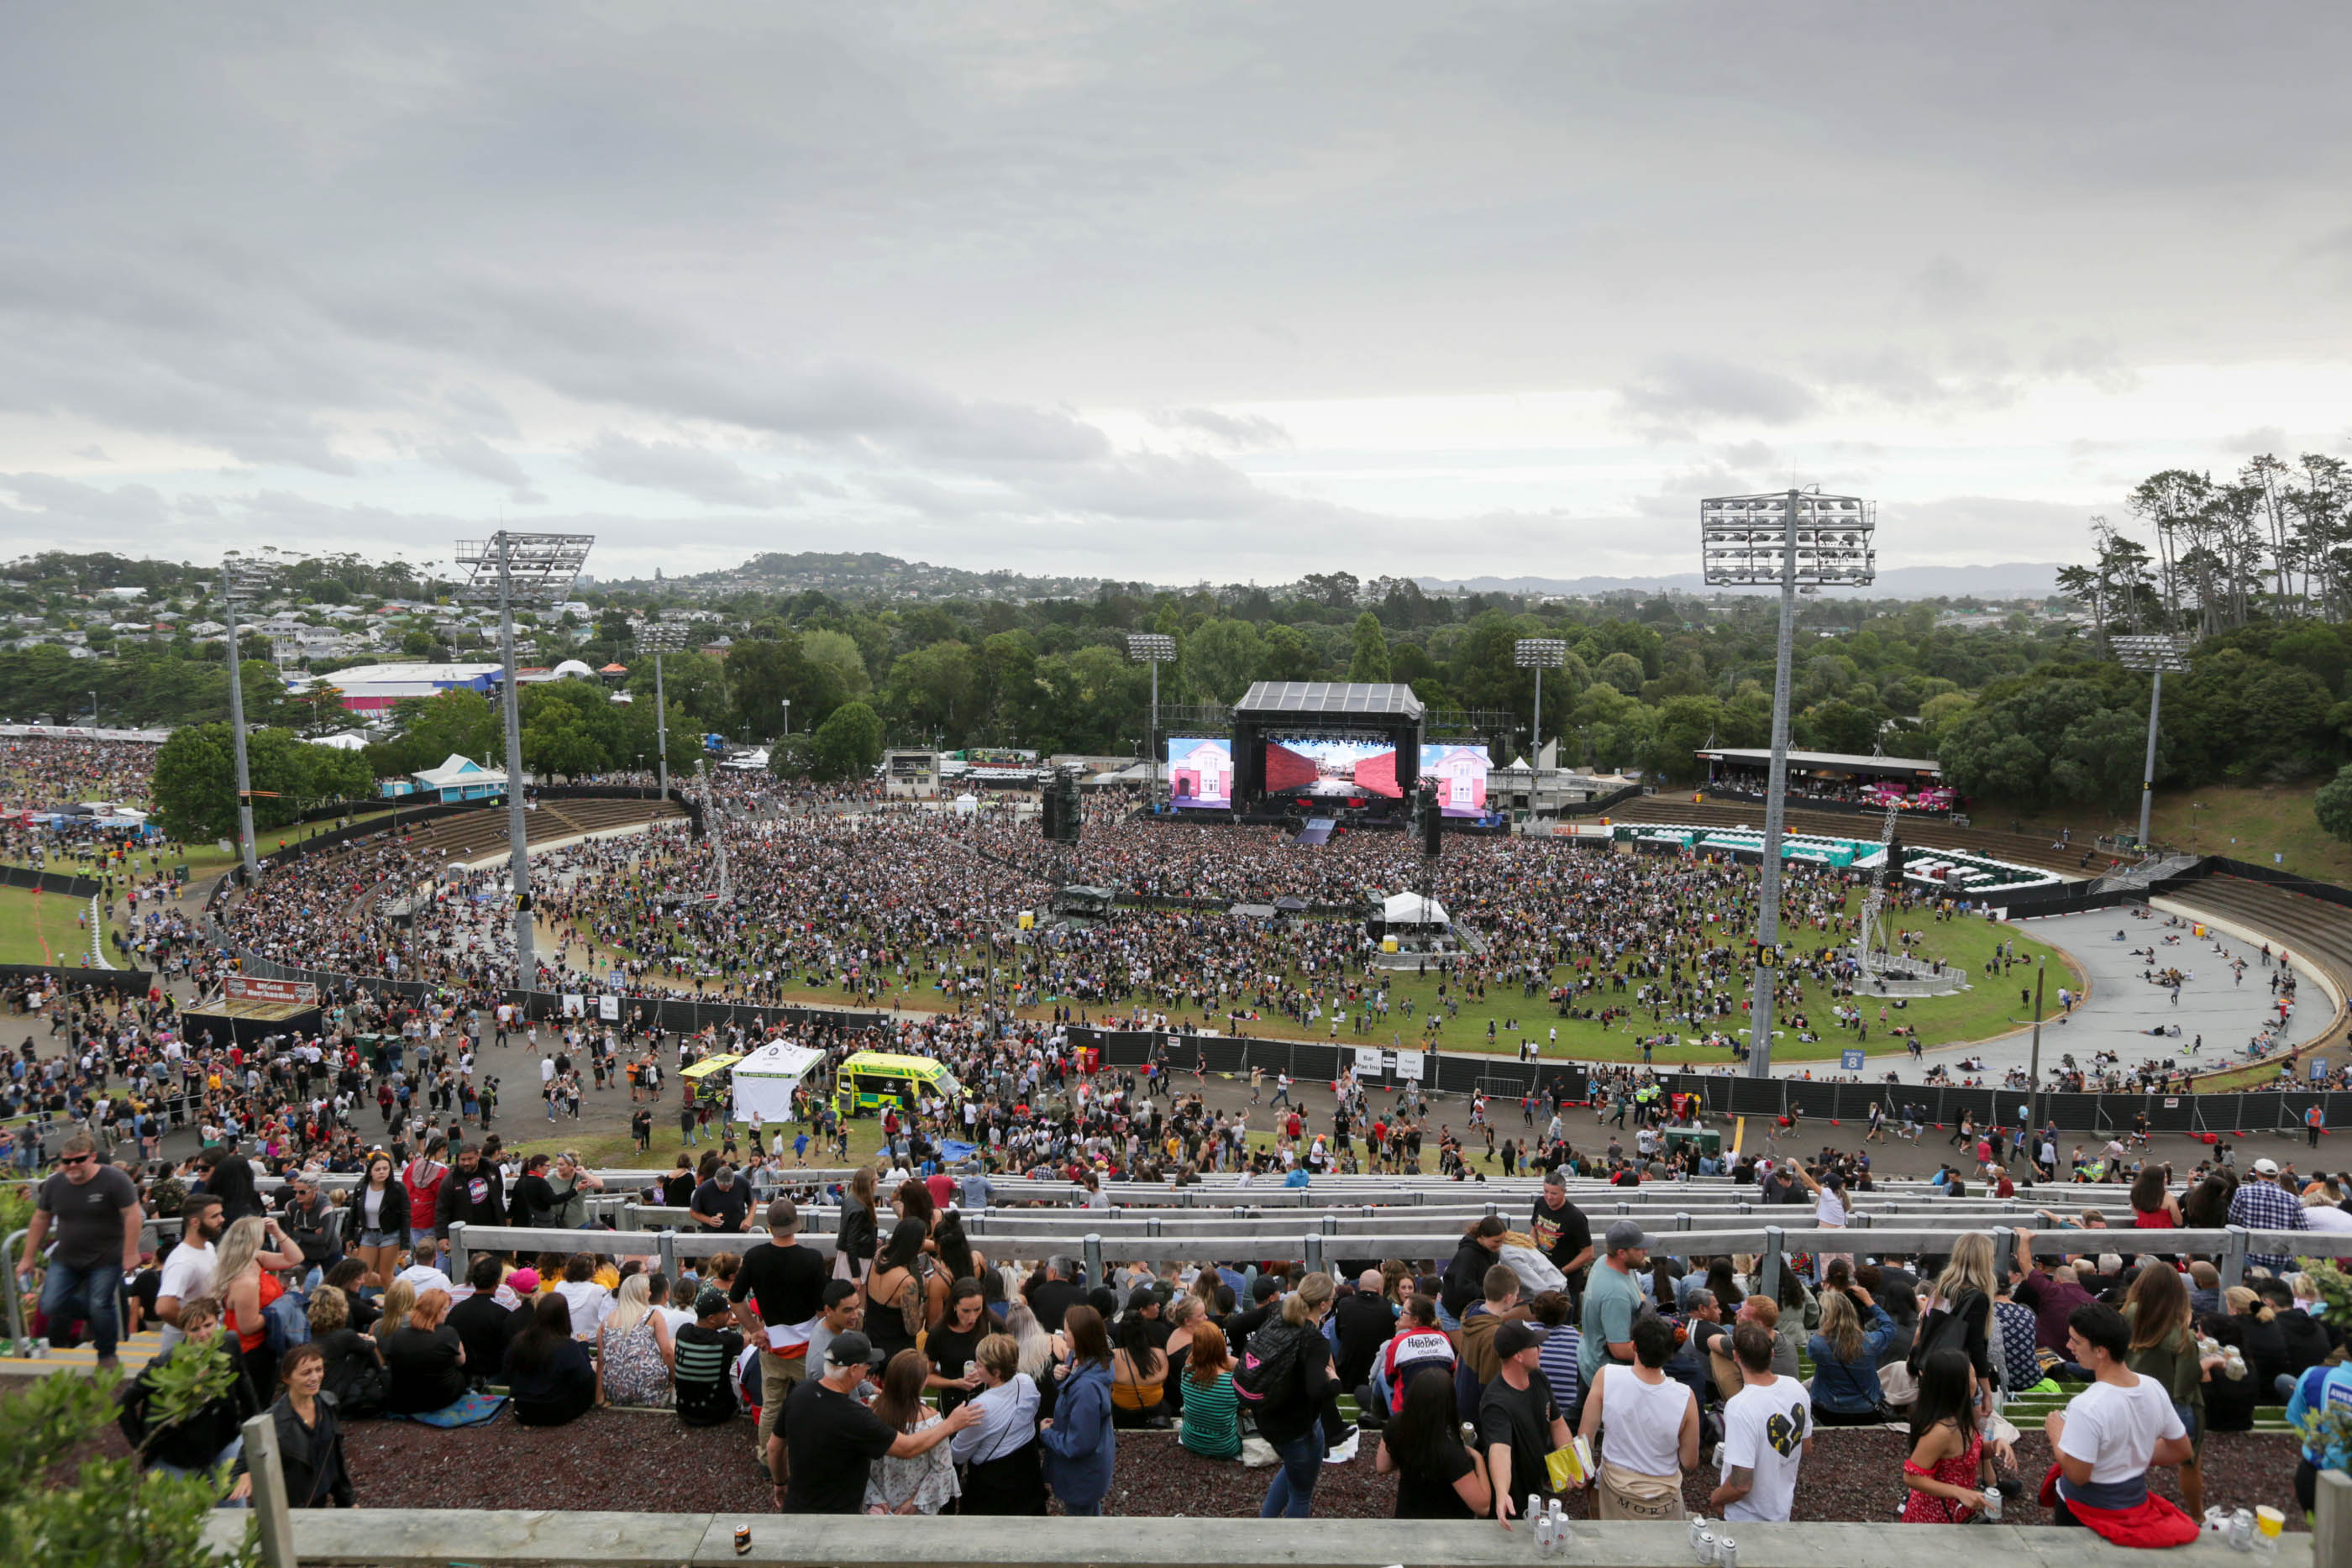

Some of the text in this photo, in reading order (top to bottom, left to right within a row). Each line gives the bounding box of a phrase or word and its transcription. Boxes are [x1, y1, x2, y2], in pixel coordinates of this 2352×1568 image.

[515, 894, 524, 911] 7
[1761, 947, 1774, 966] 6
[256, 983, 284, 991] Official
[611, 978, 623, 987] 12
[247, 989, 295, 1000] Merchandise
[1848, 1057, 1857, 1068] 8
[2315, 1065, 2323, 1076] 7
